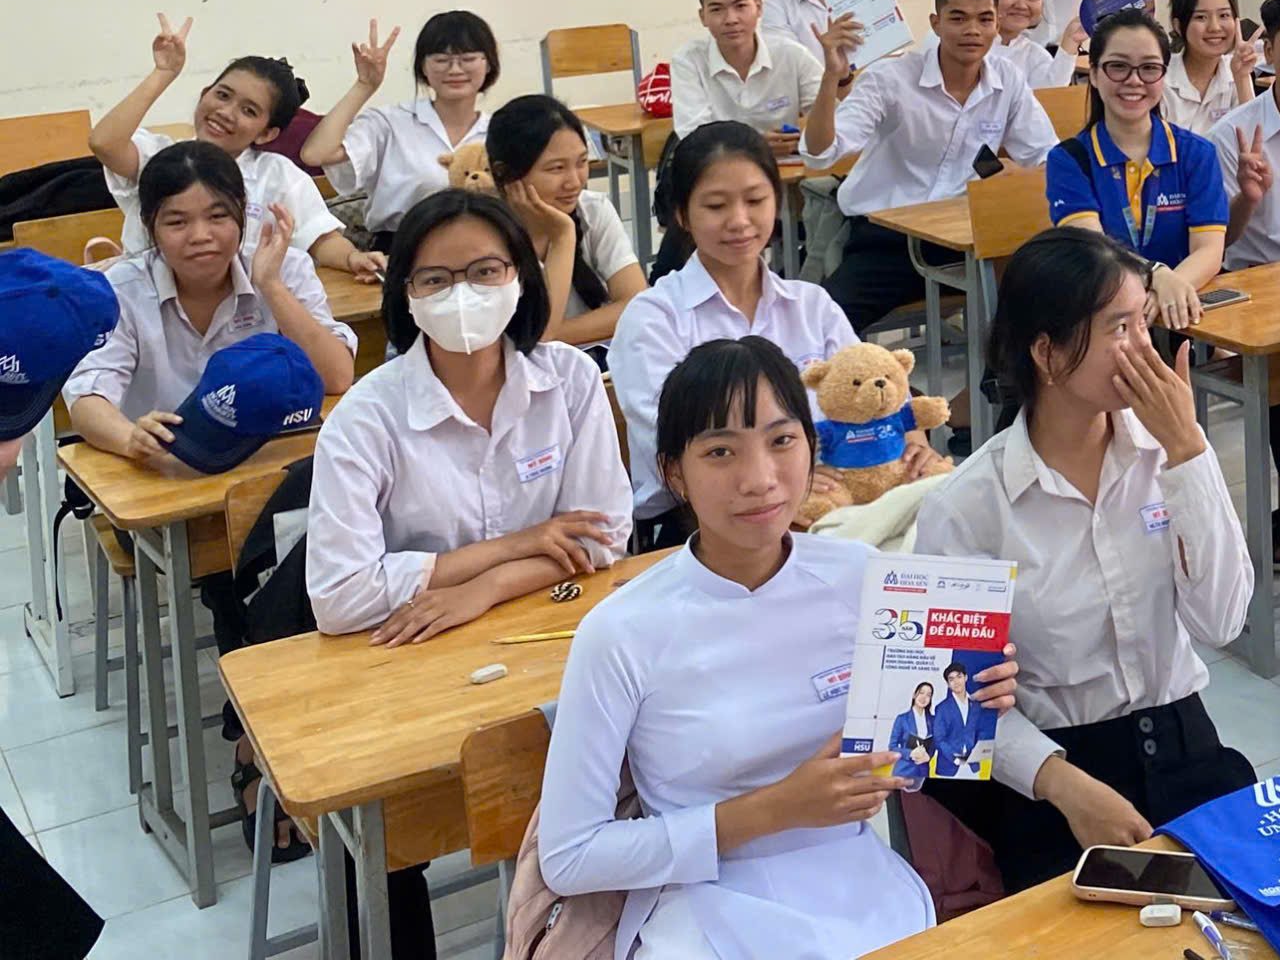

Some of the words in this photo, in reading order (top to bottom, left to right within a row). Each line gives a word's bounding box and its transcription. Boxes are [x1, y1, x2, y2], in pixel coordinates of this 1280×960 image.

[283, 407, 313, 426] HSU
[872, 608, 924, 642] 35
[931, 612, 962, 624] KHÁC
[963, 612, 986, 627] BIỆT
